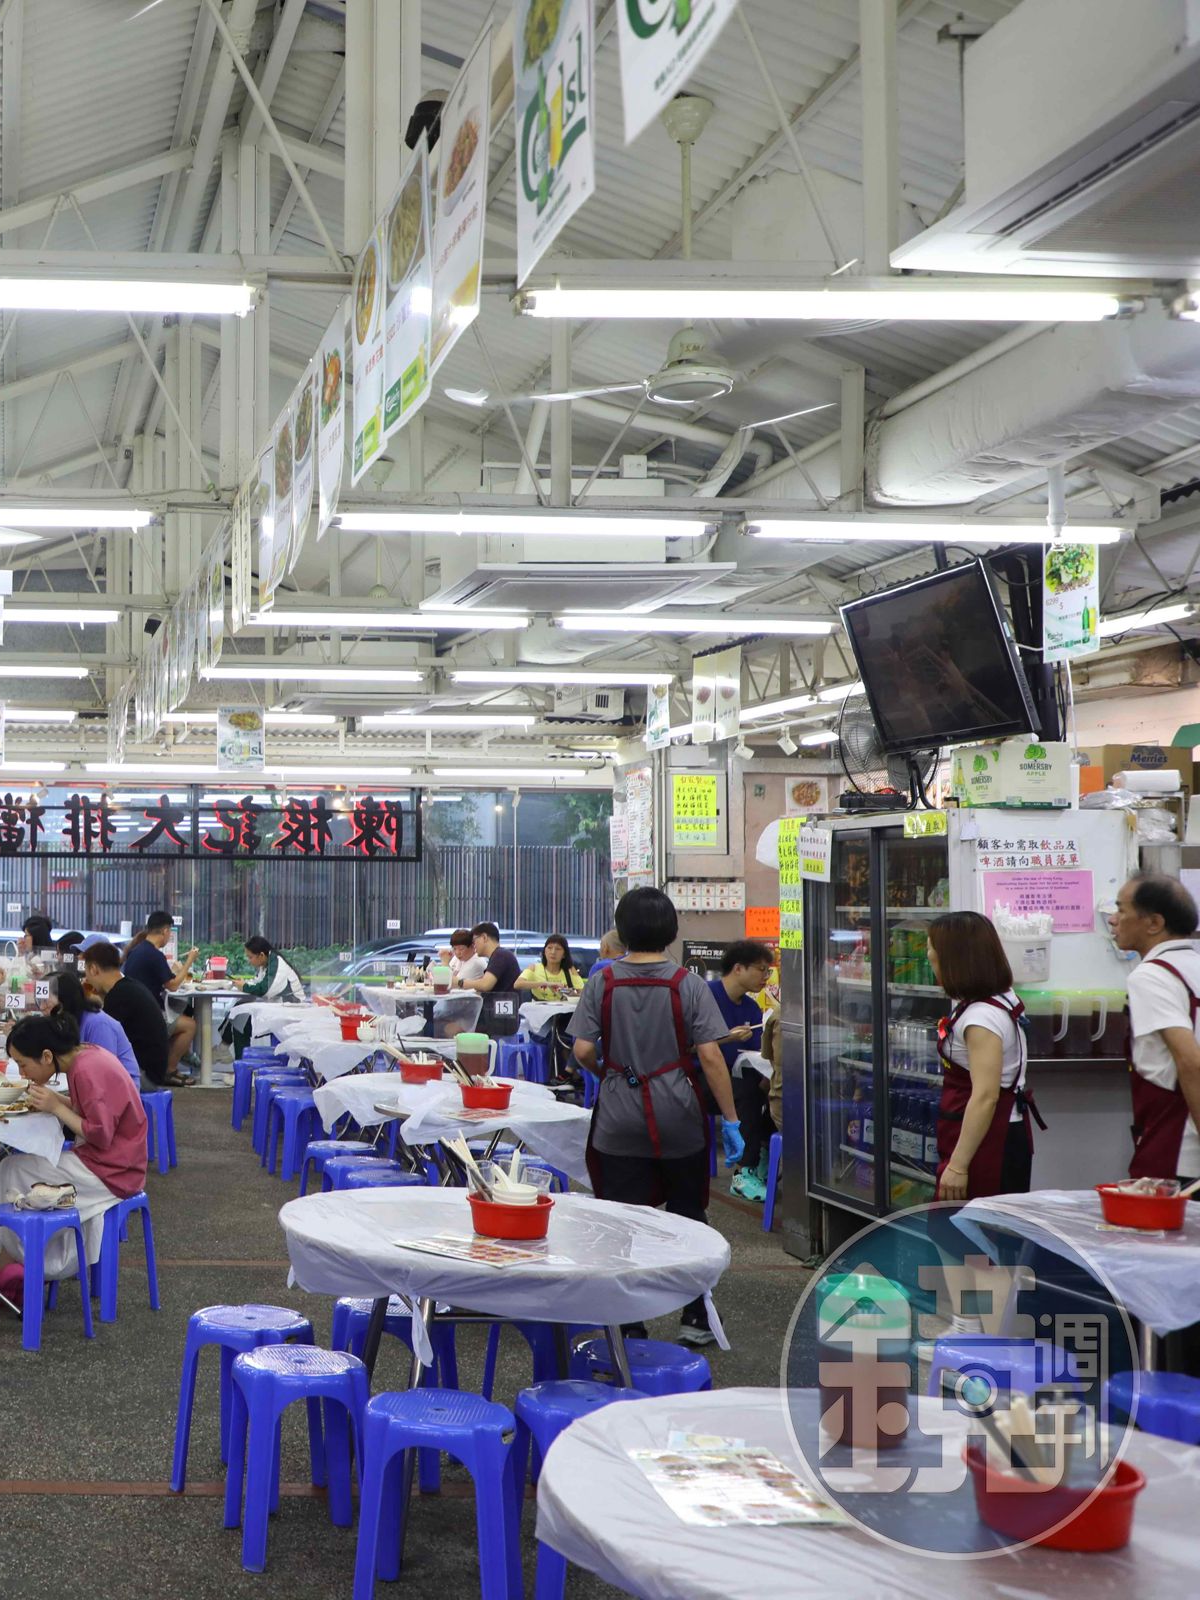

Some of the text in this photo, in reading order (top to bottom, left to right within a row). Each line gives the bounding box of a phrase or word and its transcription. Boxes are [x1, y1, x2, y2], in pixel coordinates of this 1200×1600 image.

[1130, 753, 1168, 763] Merries
[1019, 763, 1052, 771] SOMERSBY
[971, 775, 993, 784] SOMERSBY
[977, 839, 1077, 851] 顧客如需取飲品及
[980, 854, 1080, 868] 啤酒請向職員落單
[36, 986, 48, 995] 26
[7, 995, 20, 1007] 25
[497, 1002, 509, 1013] 15
